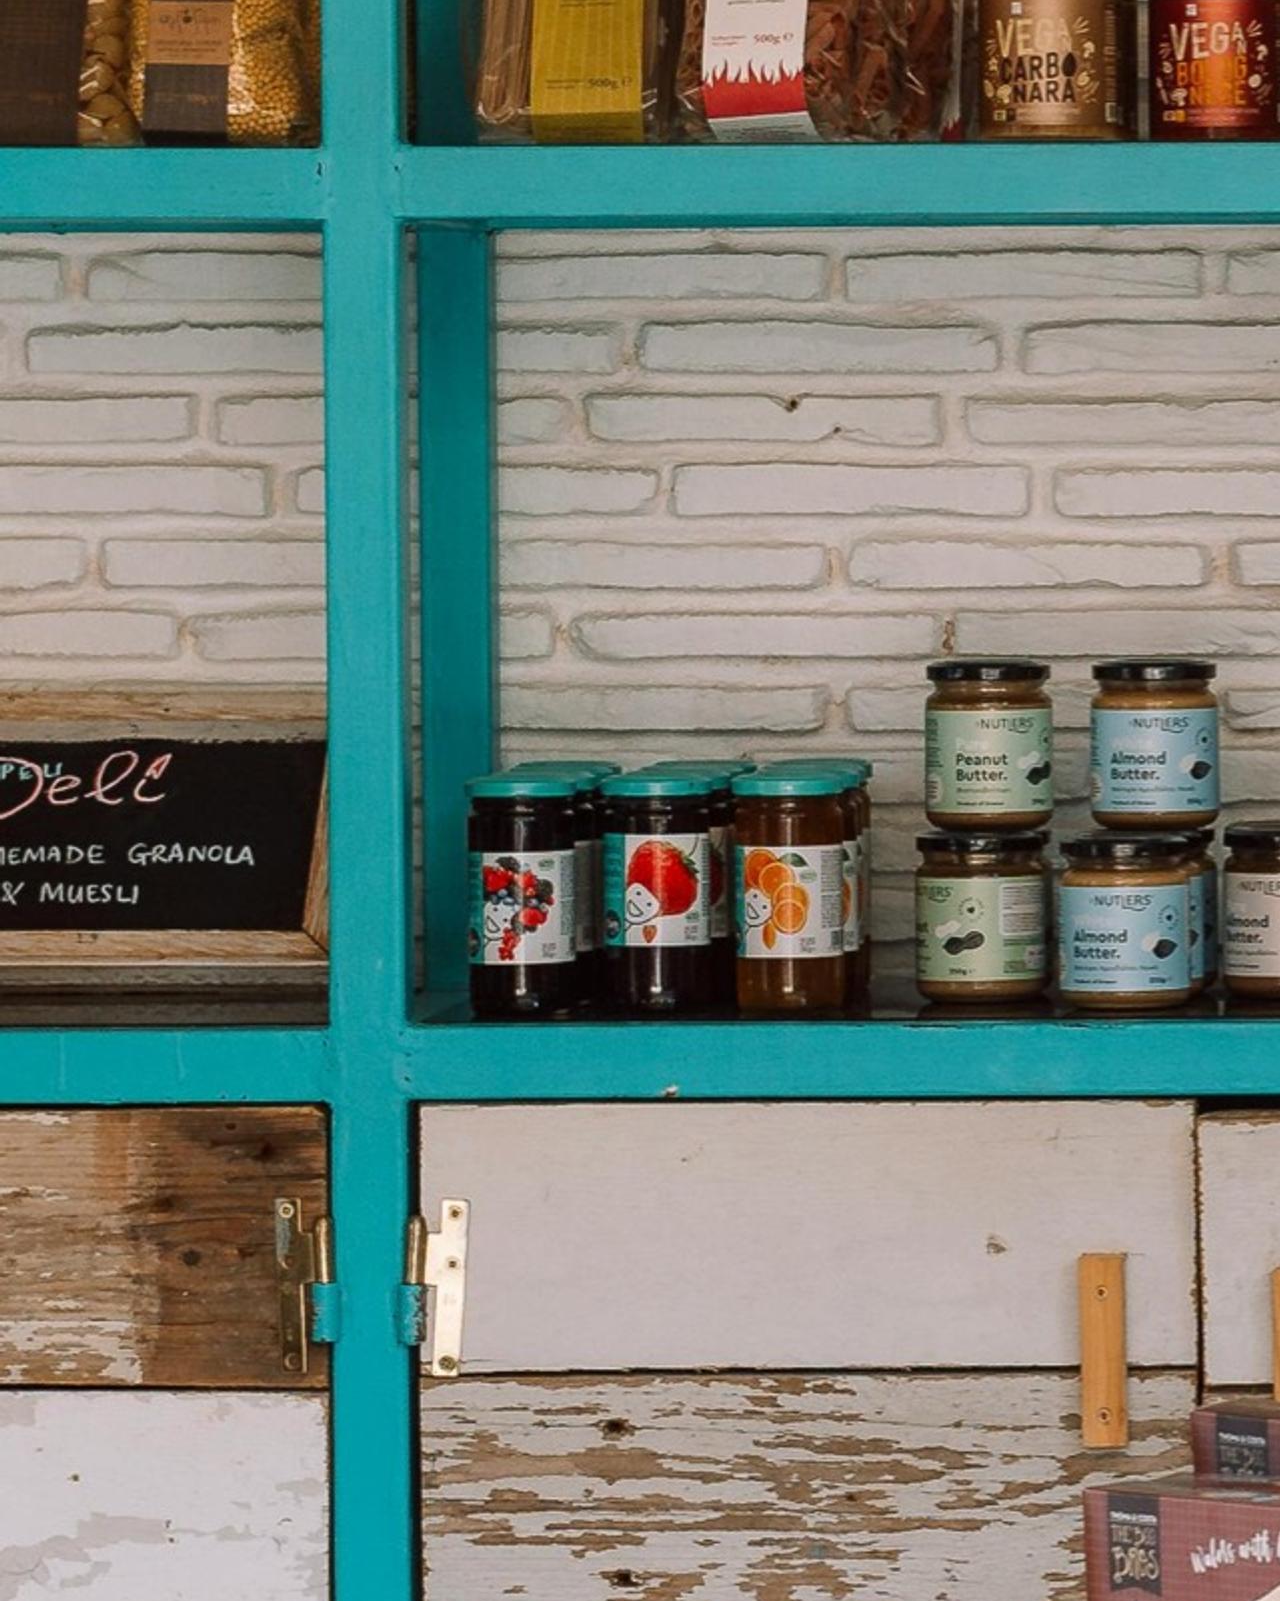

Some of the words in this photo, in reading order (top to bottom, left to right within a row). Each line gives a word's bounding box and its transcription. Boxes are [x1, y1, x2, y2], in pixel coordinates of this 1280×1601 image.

[956, 752, 1009, 767] Peanut
[1110, 751, 1167, 766] Almond
[127, 842, 256, 866] GRANOLA
[39, 881, 140, 905] MUESLI
[1074, 929, 1128, 944] Almond
